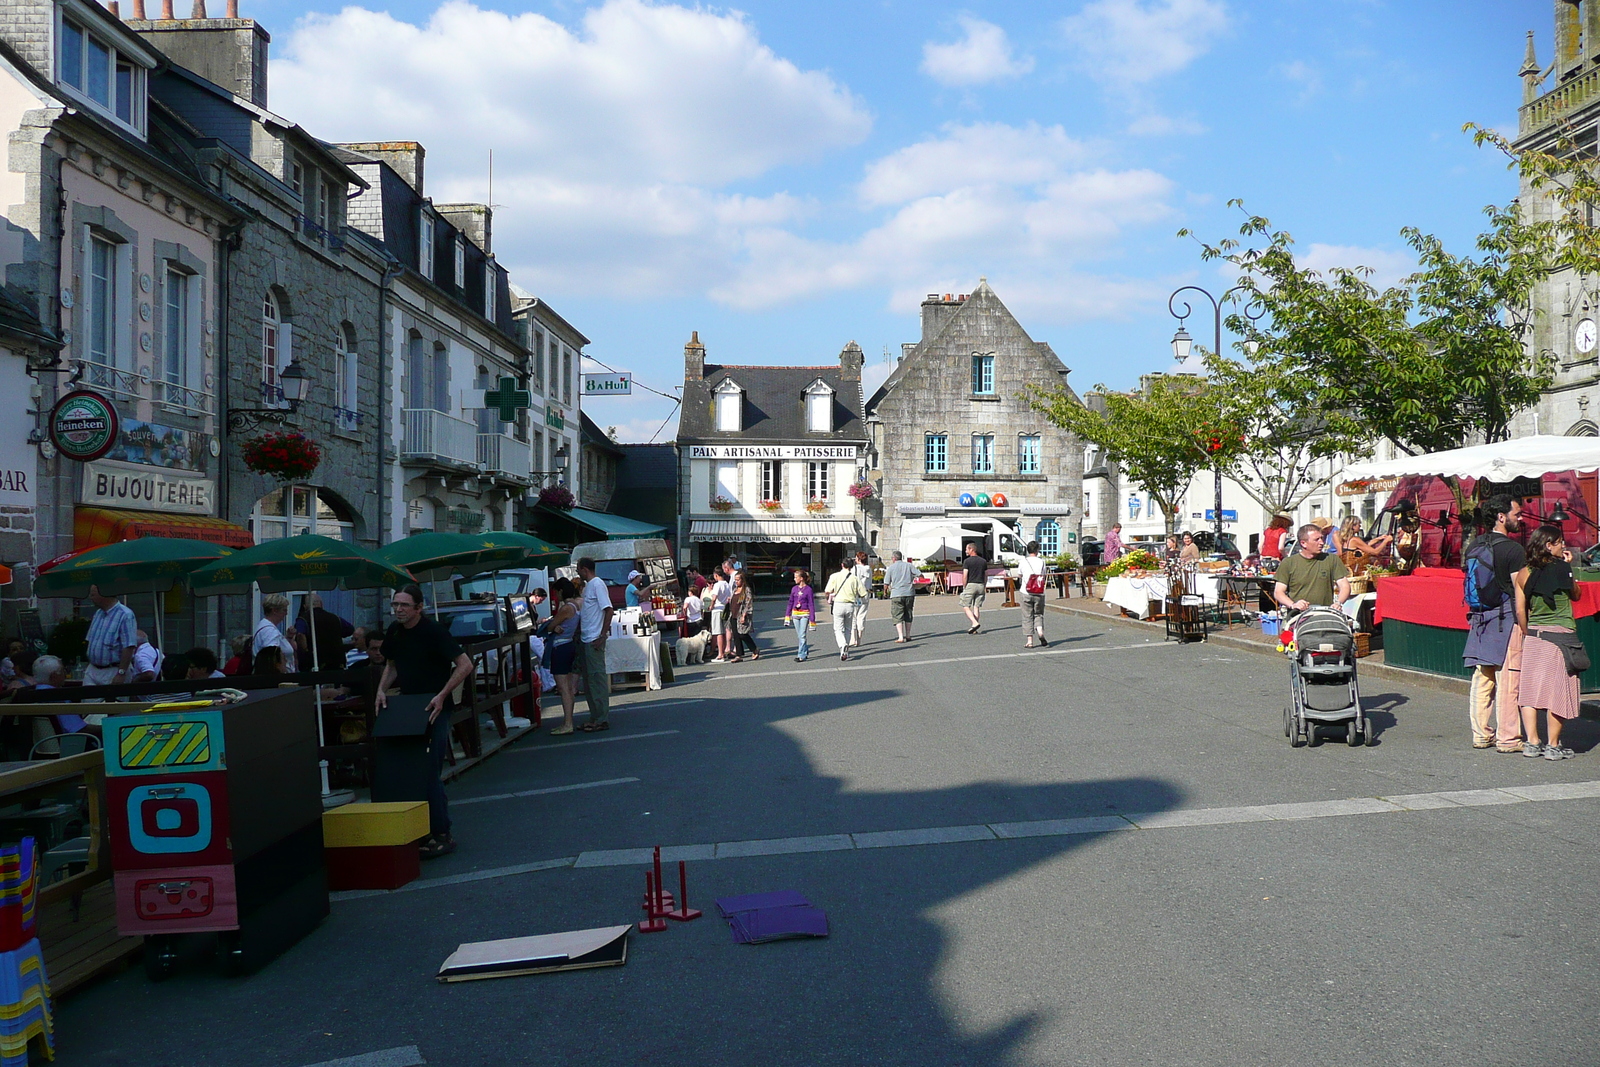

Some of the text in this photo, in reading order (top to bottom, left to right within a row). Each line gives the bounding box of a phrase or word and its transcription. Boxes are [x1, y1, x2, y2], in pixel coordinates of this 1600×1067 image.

[57, 419, 104, 432] Heineken
[692, 447, 717, 457] PAIN
[723, 447, 784, 457] ARTISANAL
[793, 447, 854, 457] PATISSERIE
[0, 469, 29, 492] AR
[95, 473, 205, 506] BIJOUTERIE
